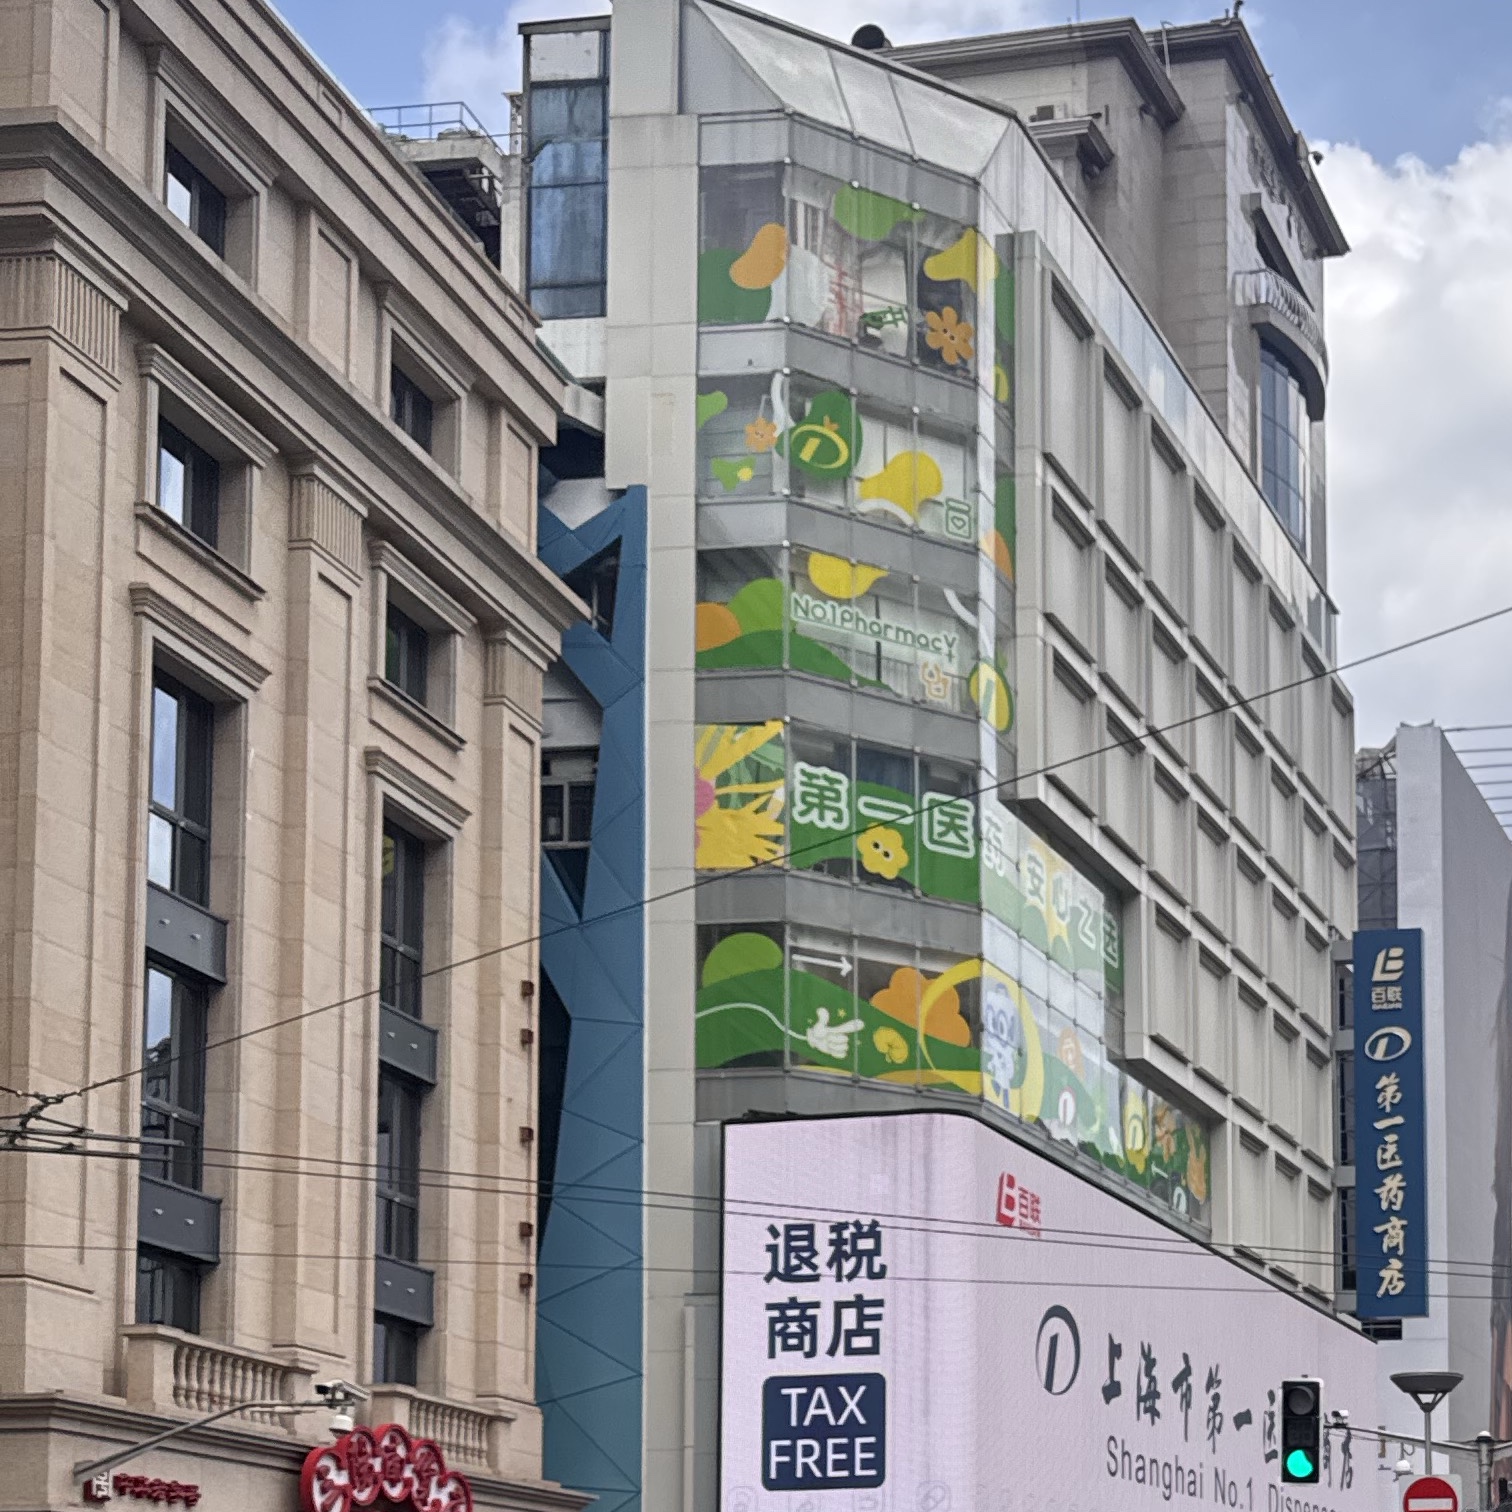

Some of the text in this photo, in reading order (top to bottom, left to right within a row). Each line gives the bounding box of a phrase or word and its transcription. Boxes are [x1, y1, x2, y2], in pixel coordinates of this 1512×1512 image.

[1372, 1072, 1408, 1299] 第一医药商店
[763, 1218, 888, 1284] 退税
[764, 1293, 885, 1360] 商店
[780, 1384, 867, 1427] TAX
[769, 1436, 878, 1480] FREE
[1106, 1434, 1204, 1501] Shanghai
[1214, 1467, 1253, 1512] No.1
